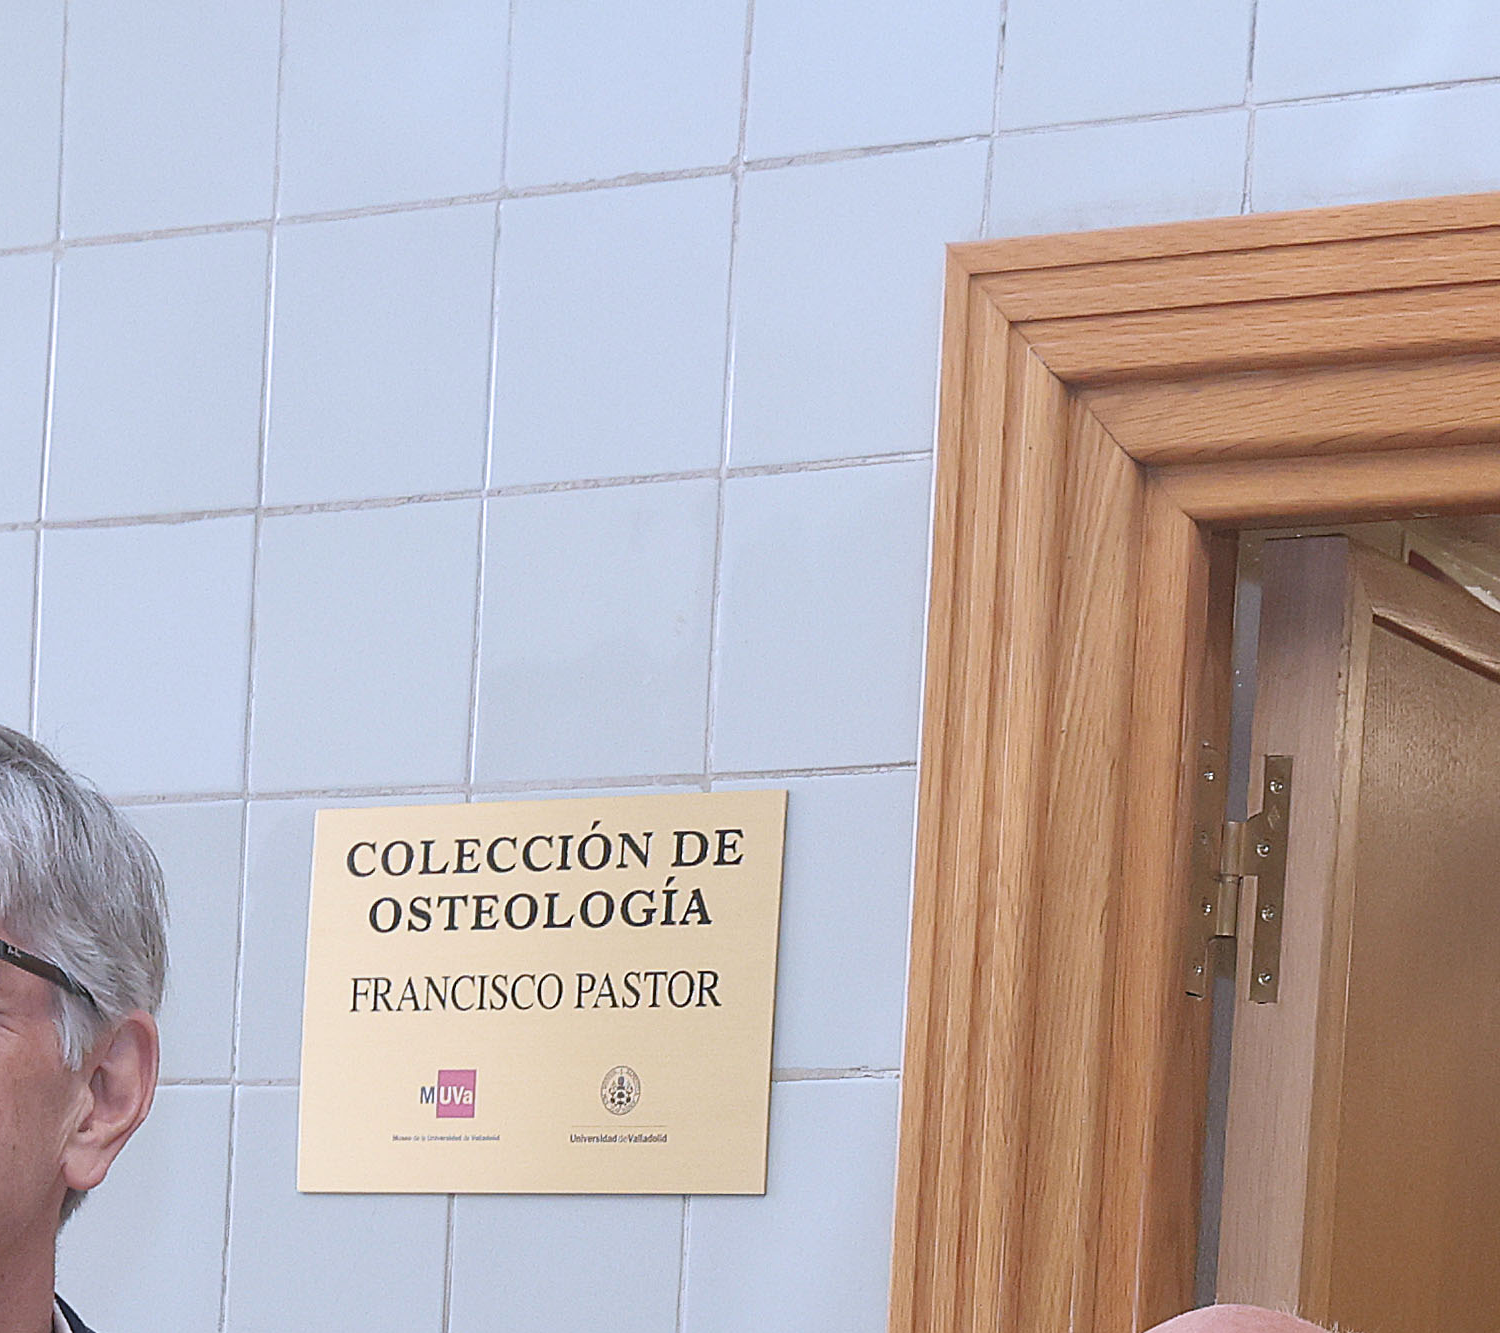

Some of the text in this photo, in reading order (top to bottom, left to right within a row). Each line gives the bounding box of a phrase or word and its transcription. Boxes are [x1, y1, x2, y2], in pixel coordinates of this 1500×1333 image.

[346, 820, 745, 878] COLECCIÓN DE
[368, 875, 713, 934] OSTEOLOGÍA
[349, 969, 723, 1013] FRANCISCO PASTOR
[569, 1133, 618, 1143] Universidad
